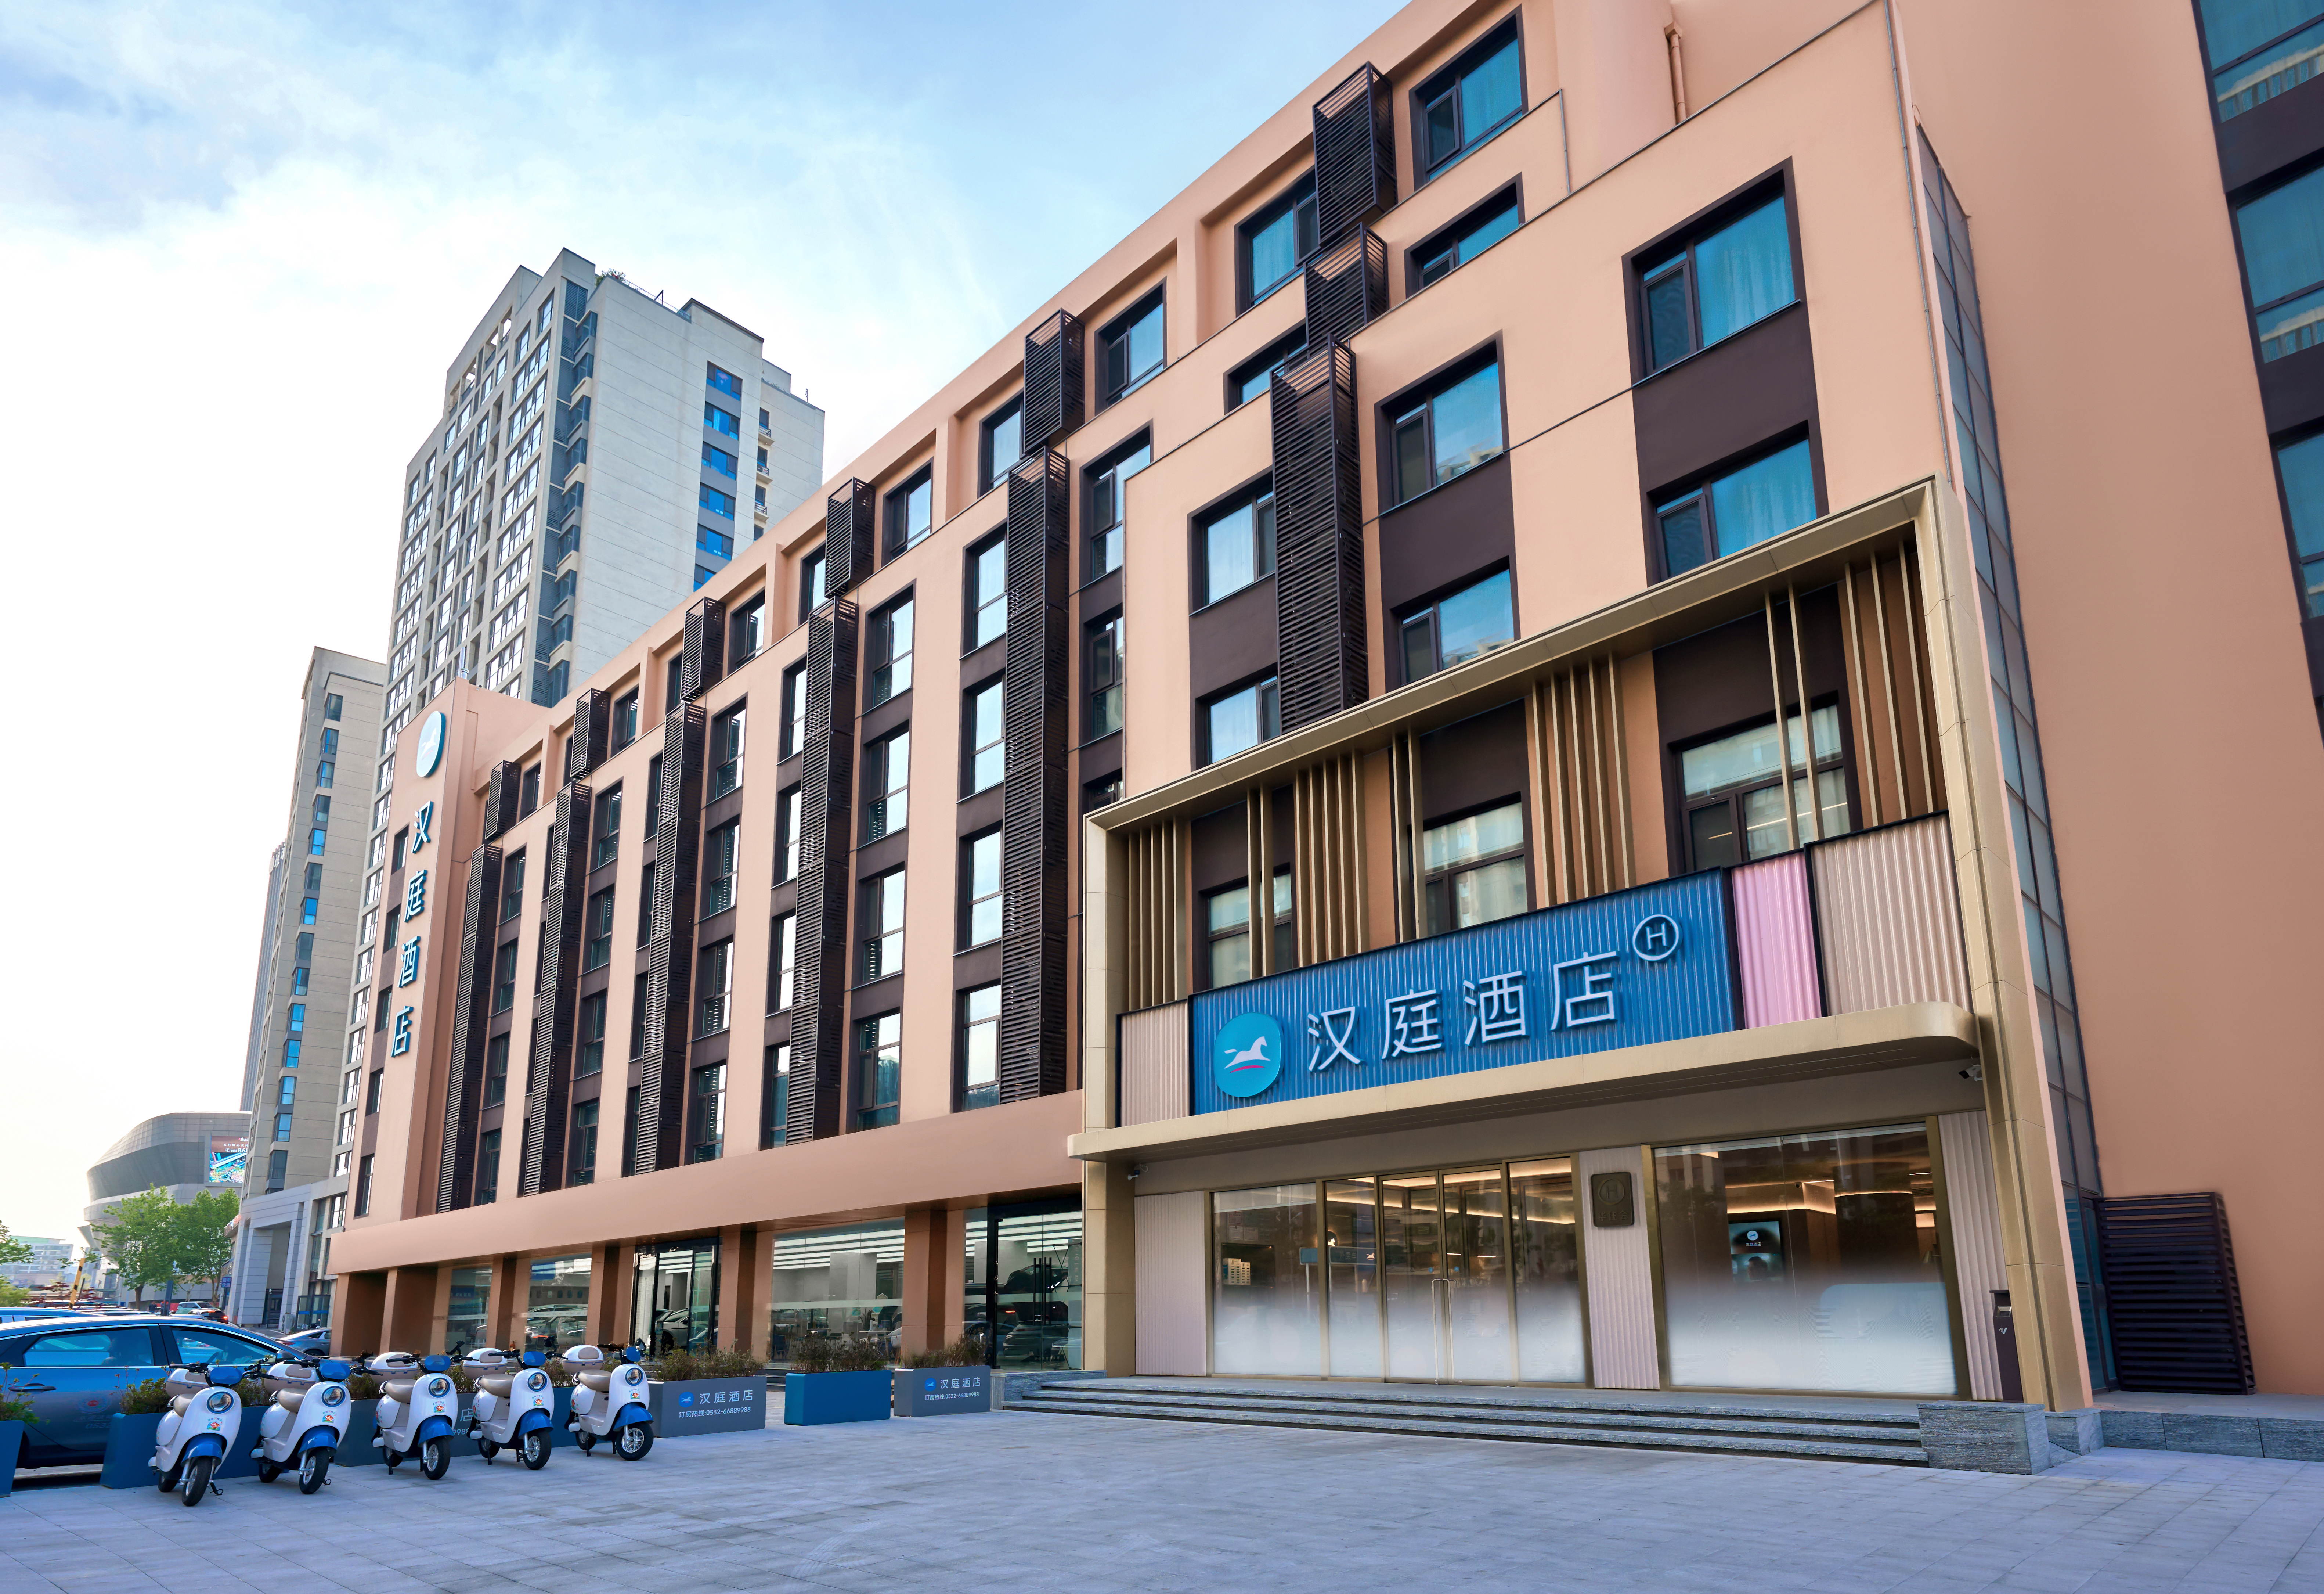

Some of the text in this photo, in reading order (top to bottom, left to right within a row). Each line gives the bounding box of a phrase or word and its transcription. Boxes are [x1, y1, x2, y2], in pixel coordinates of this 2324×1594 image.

[390, 801, 433, 1058] 汉庭酒店
[1307, 951, 1618, 1073] 汉庭酒店
[940, 1377, 981, 1389] 汉庭酒店
[699, 1389, 753, 1404] 汉庭酒店
[925, 1392, 979, 1401] 订房热线:0532-66889988
[679, 1407, 751, 1418] 订房热线:0532-66889988
